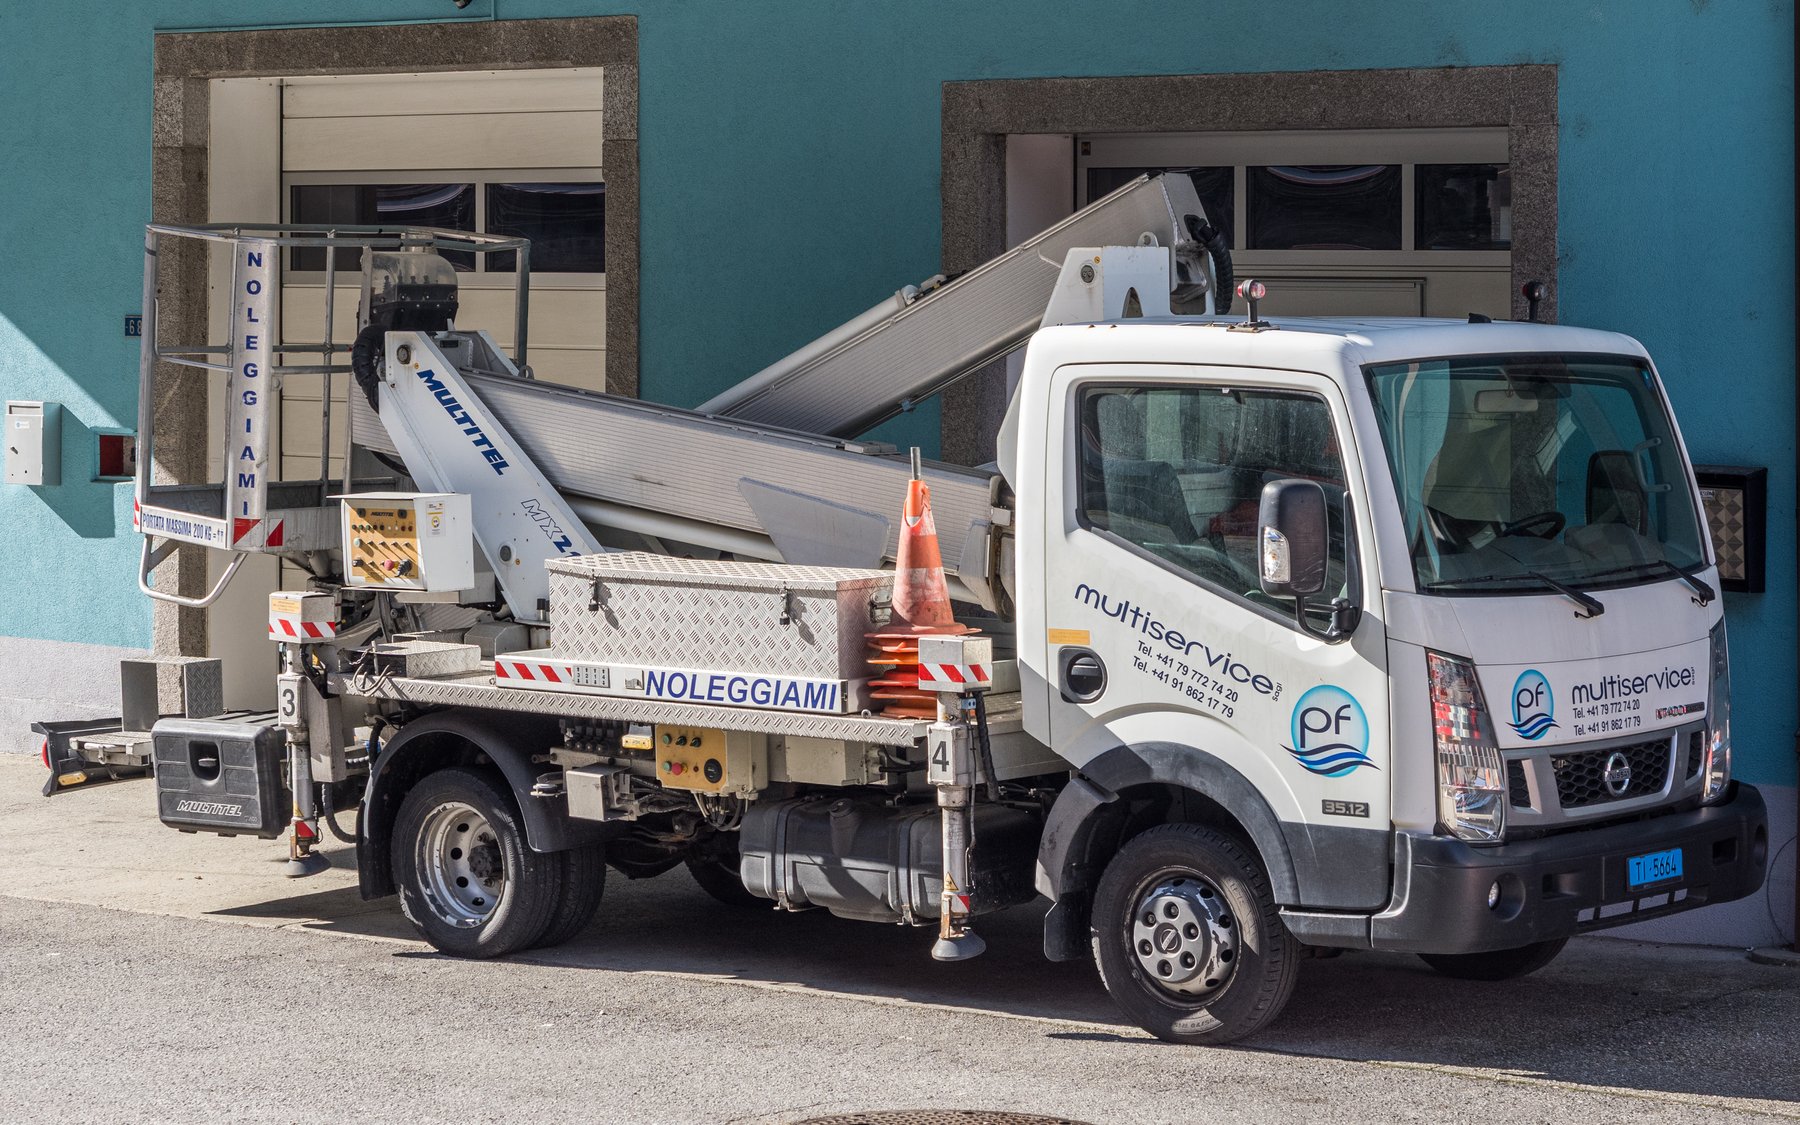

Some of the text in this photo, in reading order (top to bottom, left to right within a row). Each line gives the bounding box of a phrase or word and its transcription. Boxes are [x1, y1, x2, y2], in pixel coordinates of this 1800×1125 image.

[238, 252, 263, 516] NOLEGGIAMI
[416, 369, 510, 476] MULTITEL
[143, 513, 212, 541] PORTATA MASSIMA 200 KG
[1074, 583, 1274, 695] multiservice
[645, 670, 838, 711] NOLEGGIAMI
[1133, 656, 1234, 718] Tel. +41 91 862 17 79
[1138, 640, 1239, 703] Tel. +41 79 772 74 20
[1571, 666, 1691, 705] multiservice
[282, 688, 295, 717] 3
[1516, 681, 1545, 722] pf
[1572, 698, 1640, 719] Tel. +41 79 772 74 20
[1300, 704, 1351, 749] pf
[1573, 715, 1641, 736] Tel. +41 91 862 17 79
[932, 740, 950, 772] 4
[176, 800, 242, 817] MULTITEL
[1325, 801, 1366, 816] 35.12
[1653, 853, 1677, 878] 5664
